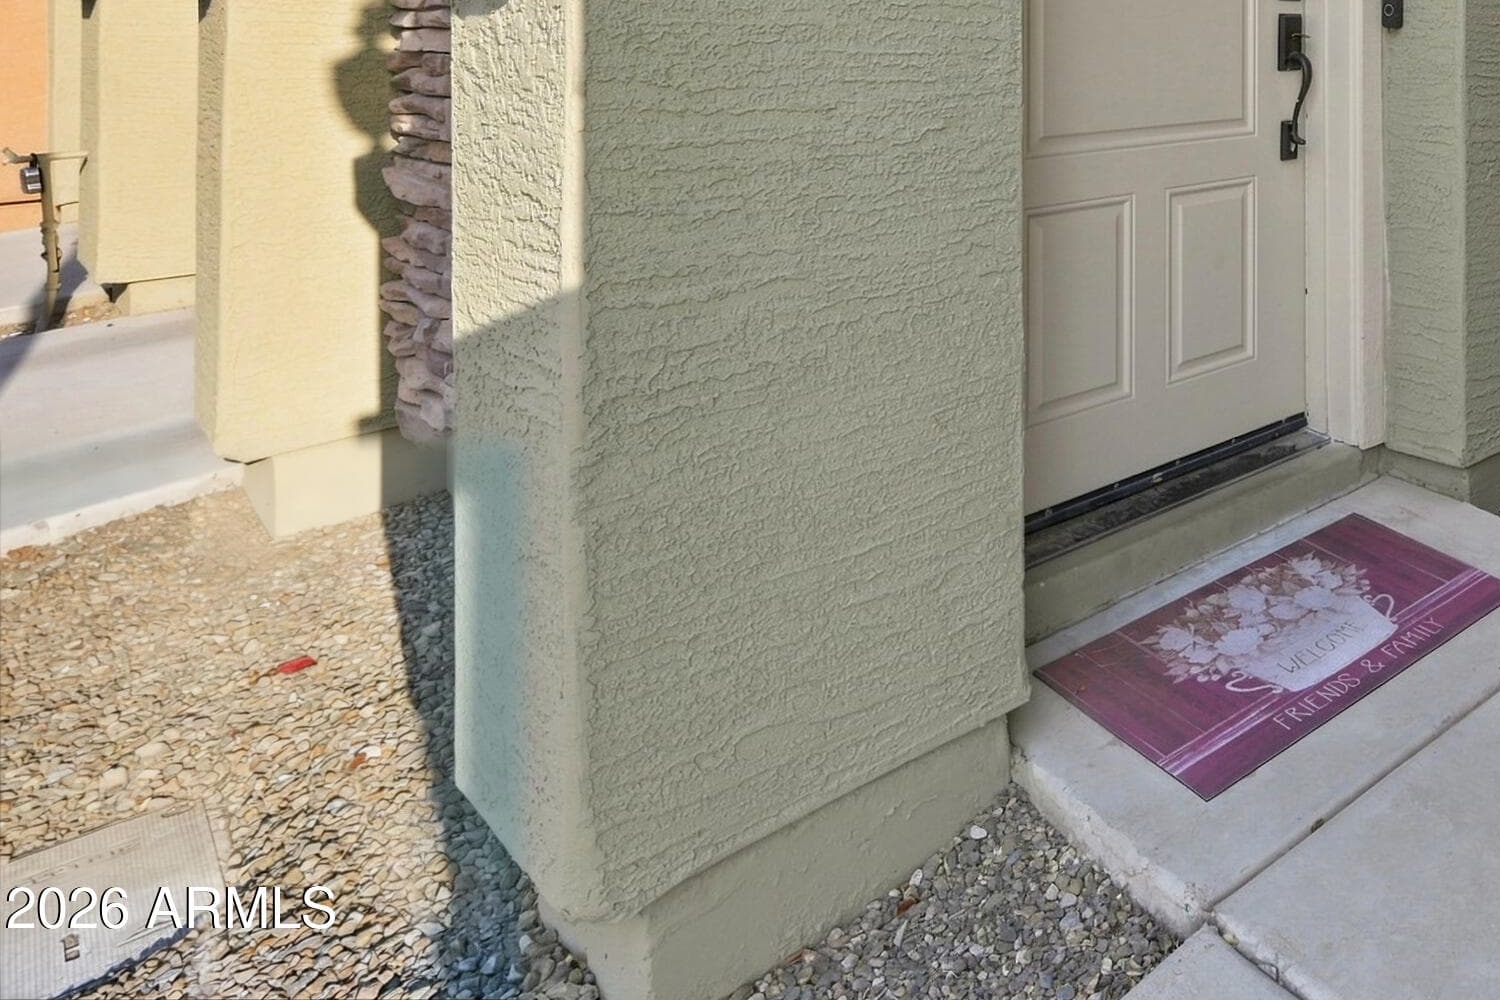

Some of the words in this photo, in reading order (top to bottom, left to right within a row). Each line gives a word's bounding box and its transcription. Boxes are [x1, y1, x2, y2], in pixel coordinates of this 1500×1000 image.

[1273, 673, 1360, 730] FRIENDS
[1361, 658, 1386, 673] &
[1380, 617, 1445, 659] FAMILY
[1277, 621, 1365, 674] WELCOME
